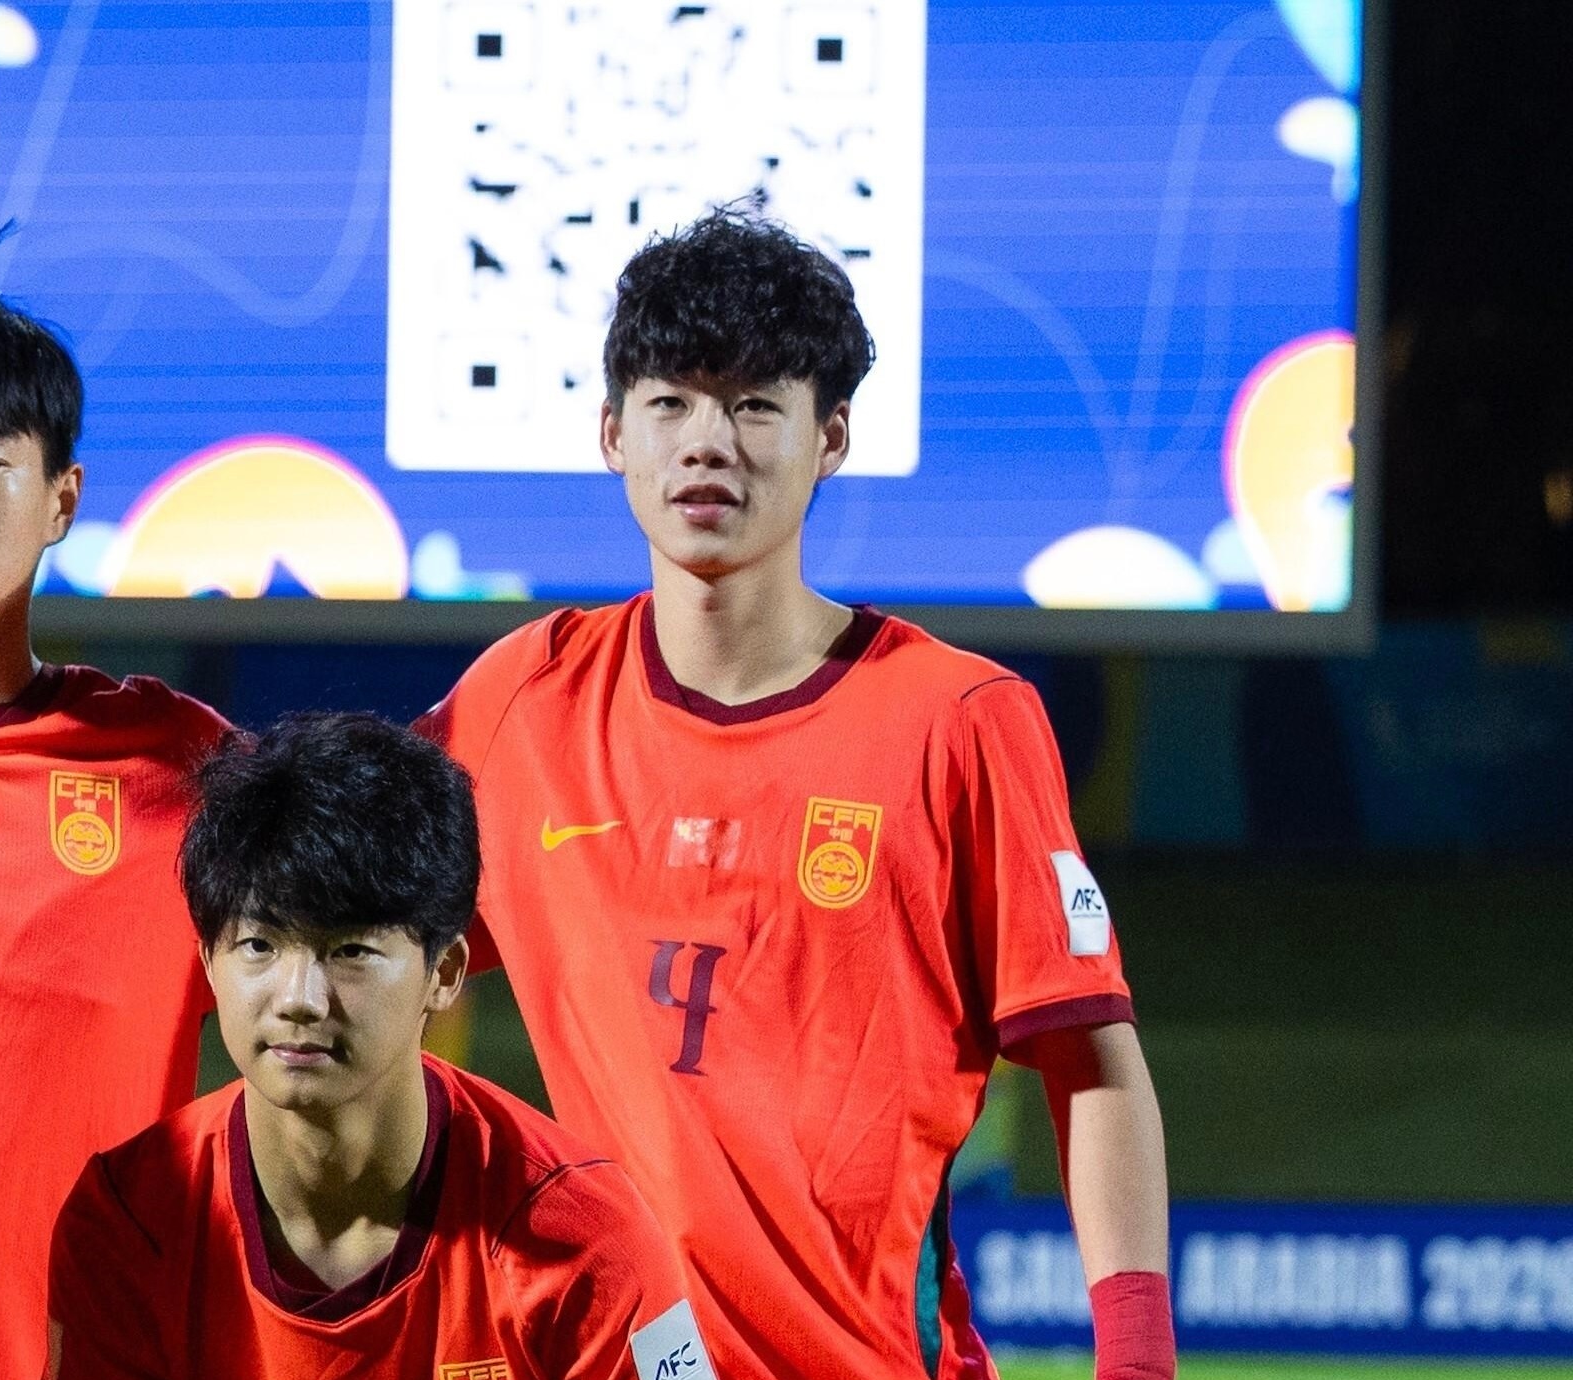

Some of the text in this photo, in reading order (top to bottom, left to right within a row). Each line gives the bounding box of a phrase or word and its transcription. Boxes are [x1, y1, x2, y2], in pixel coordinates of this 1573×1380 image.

[56, 777, 113, 799] CFA
[813, 807, 873, 831] CFA
[1070, 888, 1102, 911] AFC
[648, 939, 727, 1078] 4
[1180, 1233, 1411, 1326] ARABIA
